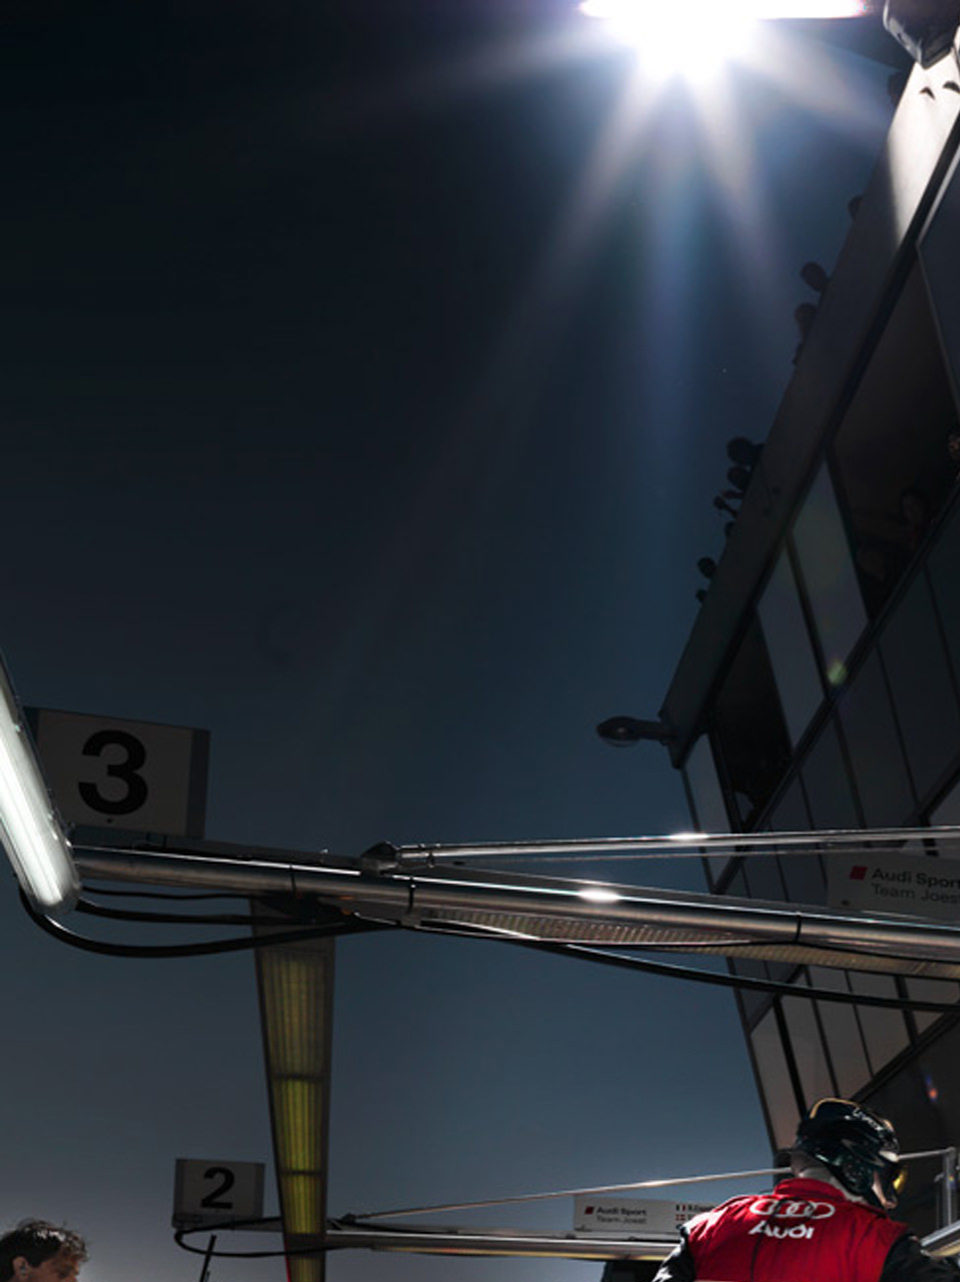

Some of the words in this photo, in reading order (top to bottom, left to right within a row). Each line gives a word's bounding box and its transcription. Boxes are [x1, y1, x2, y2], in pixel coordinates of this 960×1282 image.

[78, 729, 148, 815] 3
[871, 867, 912, 885] Audi
[872, 884, 915, 901] Team
[200, 1166, 236, 1210] 2
[747, 1221, 815, 1240] Audi
